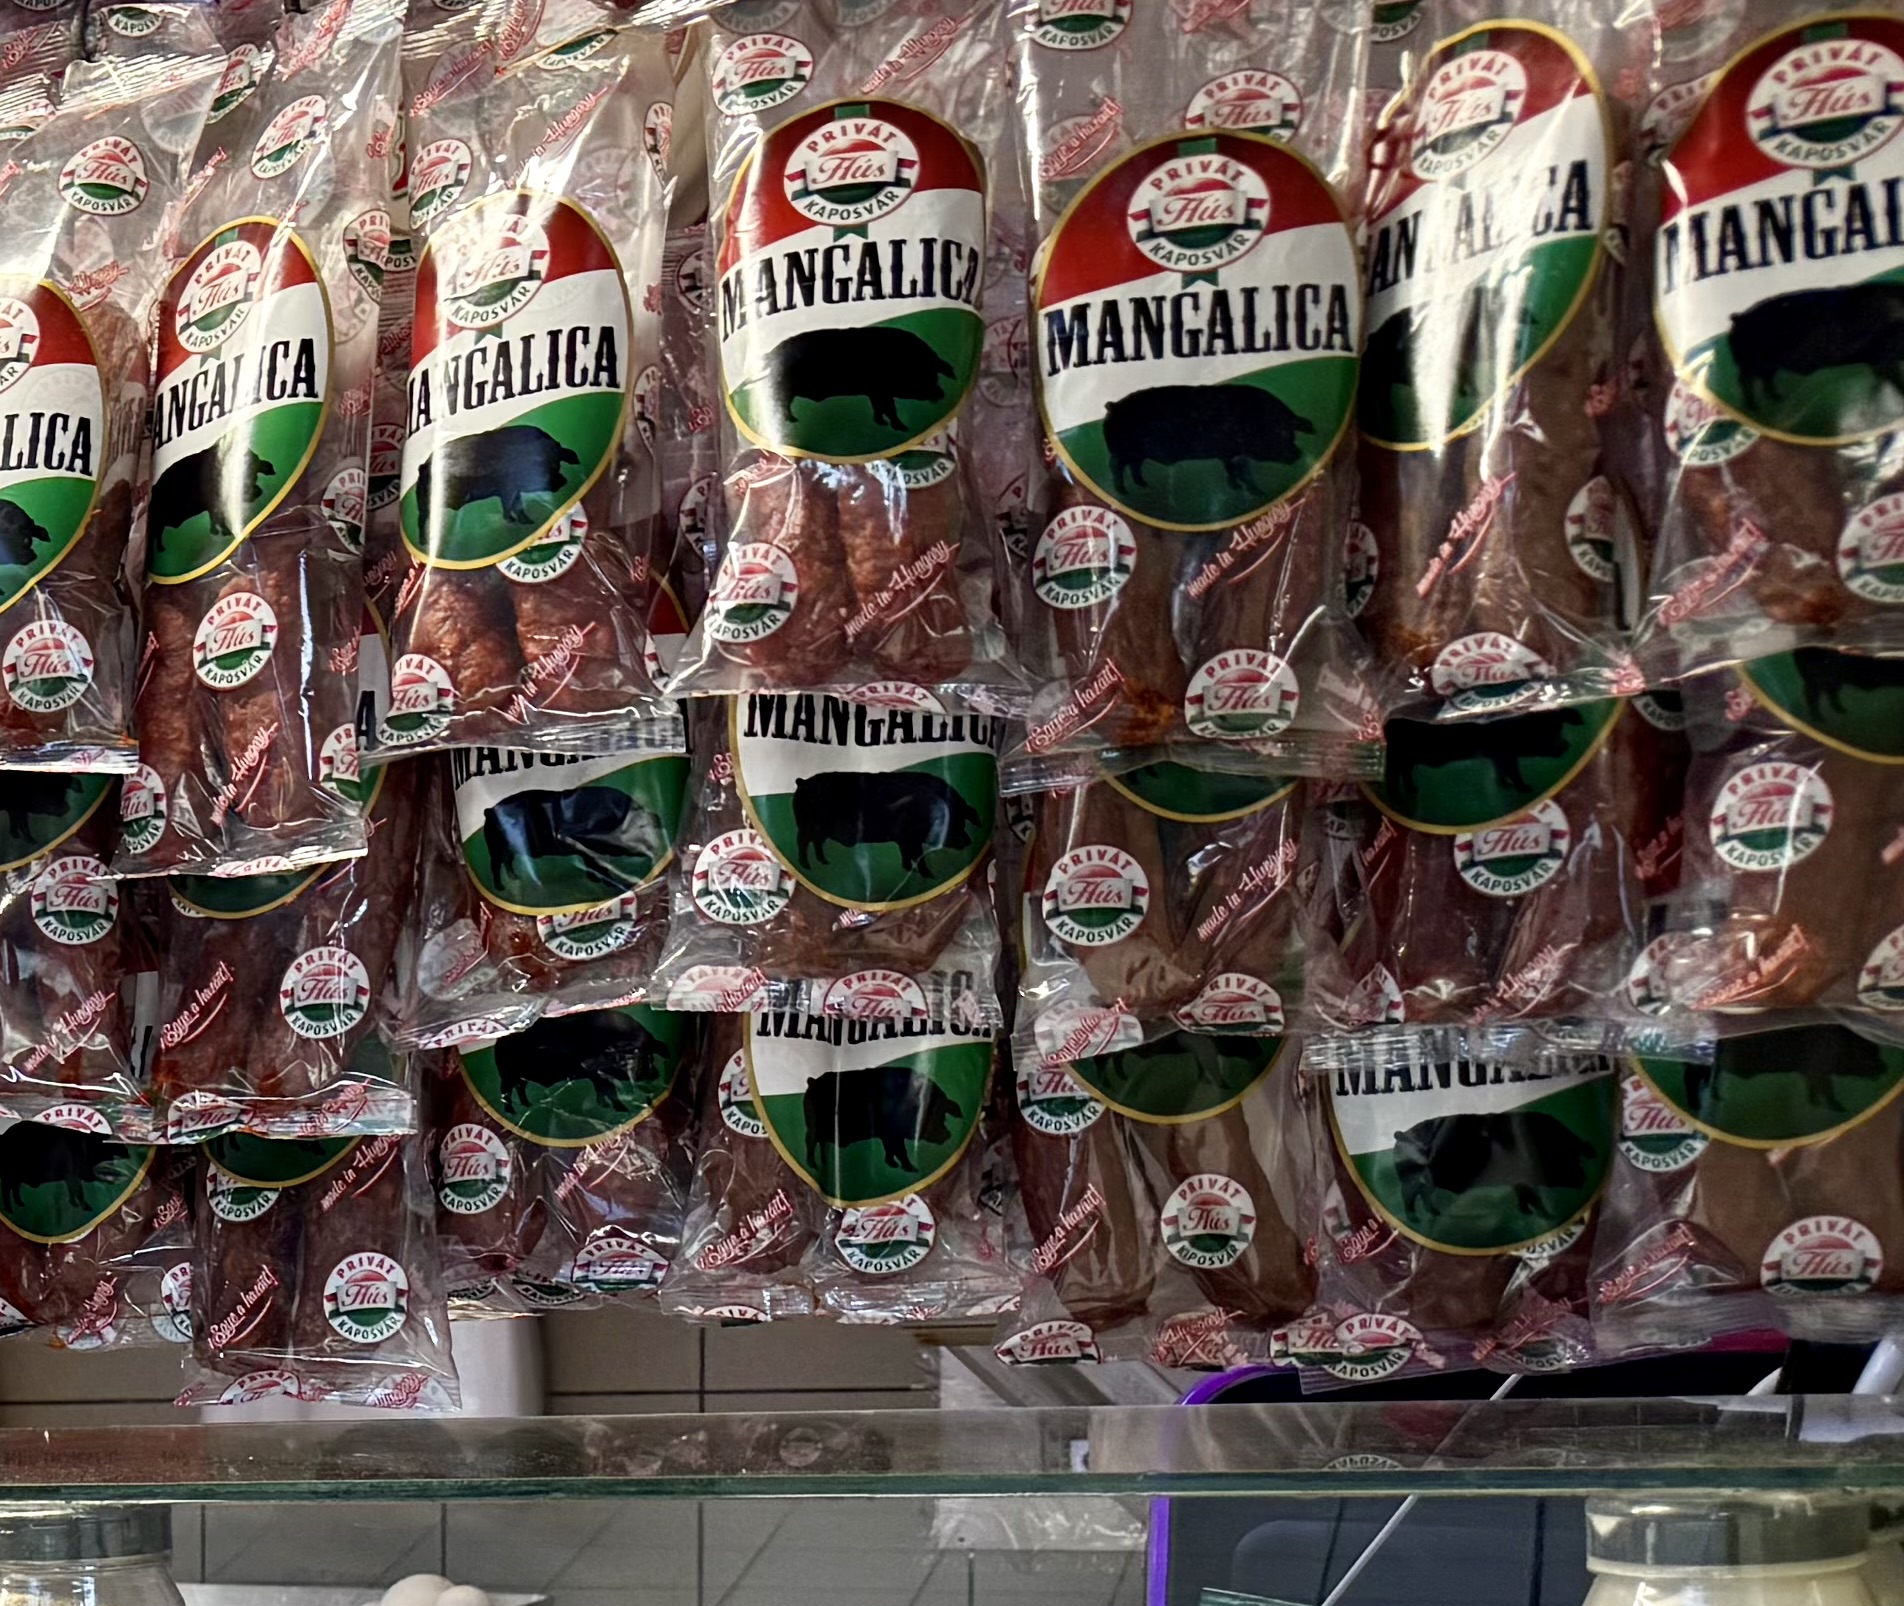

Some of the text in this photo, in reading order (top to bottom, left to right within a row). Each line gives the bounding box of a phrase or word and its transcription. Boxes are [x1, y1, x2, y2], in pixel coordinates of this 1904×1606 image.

[806, 123, 898, 154] PRIVÁT
[816, 151, 887, 182] Hús
[1149, 161, 1246, 192] PRIVÁT
[803, 189, 901, 221] KAPOSVÁR
[1162, 196, 1237, 227] Hús
[1148, 232, 1250, 267] KAPOSVÁR
[1663, 178, 1904, 294] MANGAL
[720, 237, 980, 345] MANGALICA
[1045, 282, 1352, 377] MANGALICA
[153, 337, 319, 446] ANGALICA
[1059, 846, 1137, 875] PRIVÁT
[1054, 908, 1137, 944] KAPOSVÁR
